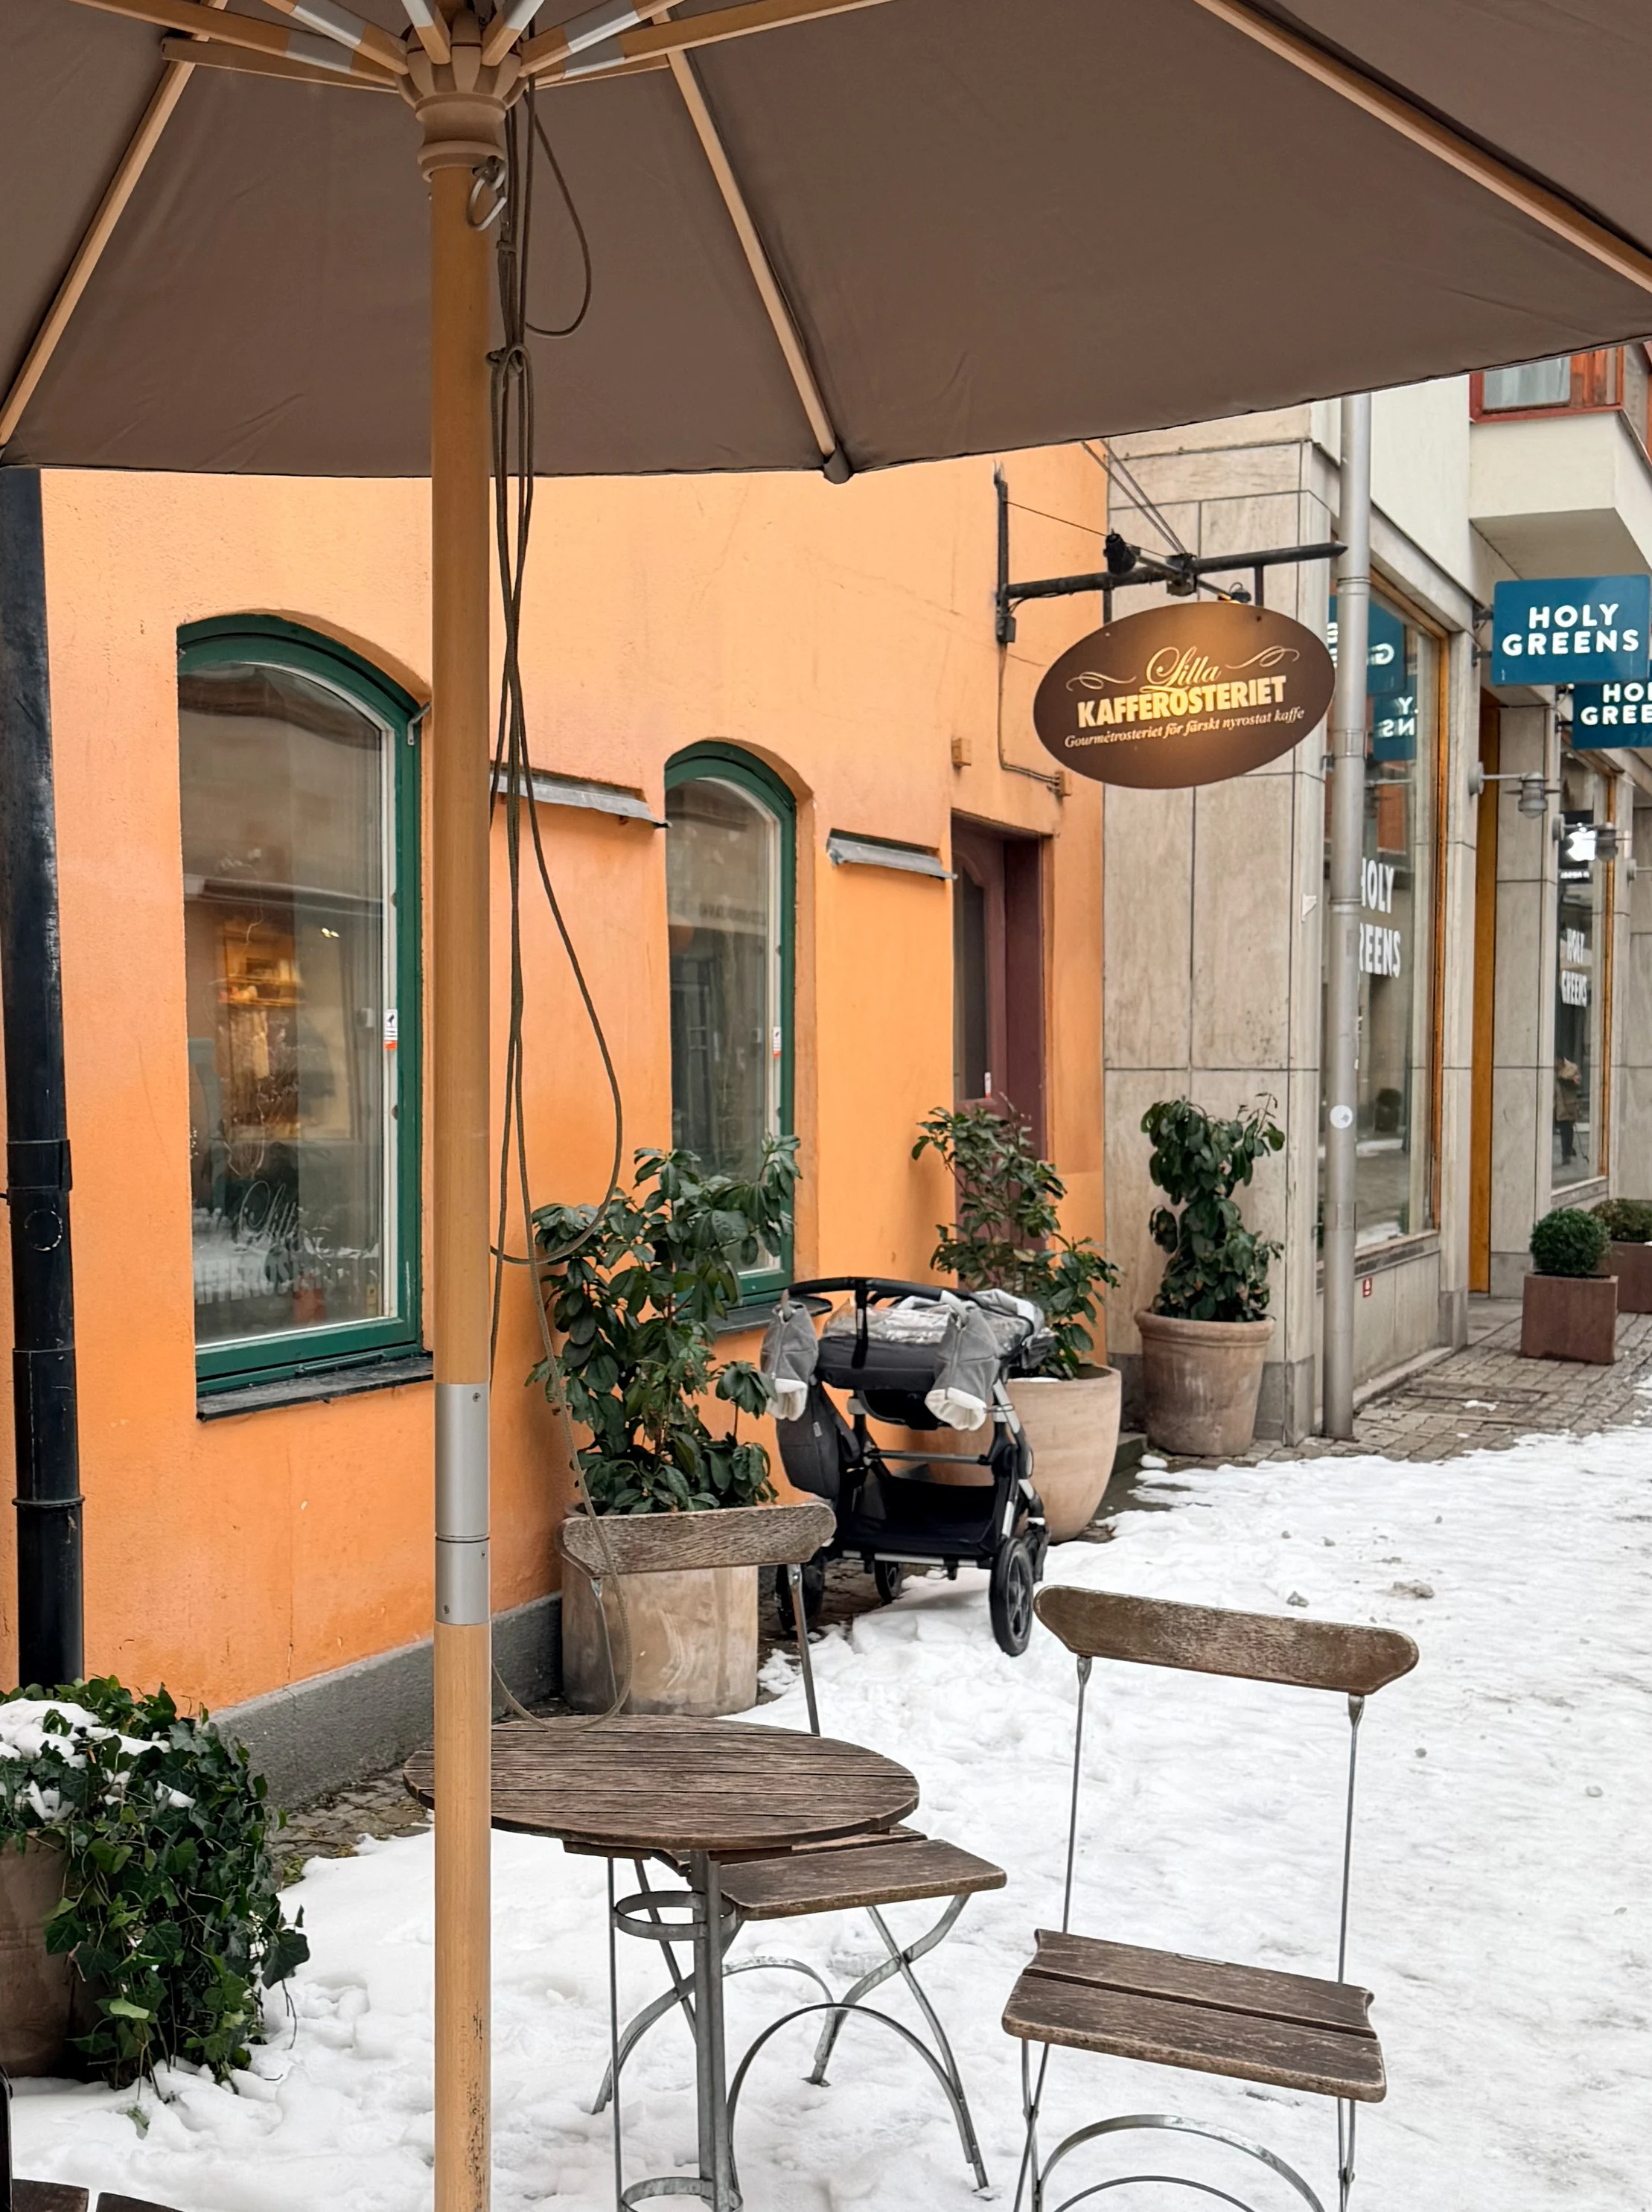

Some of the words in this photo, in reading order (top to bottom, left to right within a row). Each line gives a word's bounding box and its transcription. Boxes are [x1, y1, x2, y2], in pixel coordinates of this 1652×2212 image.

[1528, 602, 1619, 630] HOLY
[1501, 629, 1639, 657] GREENS
[1139, 646, 1222, 694] Lilla
[1162, 722, 1184, 739] för
[1182, 717, 1221, 737] färskt
[1222, 713, 1272, 731] nyrostat
[1273, 706, 1305, 724] kaffe
